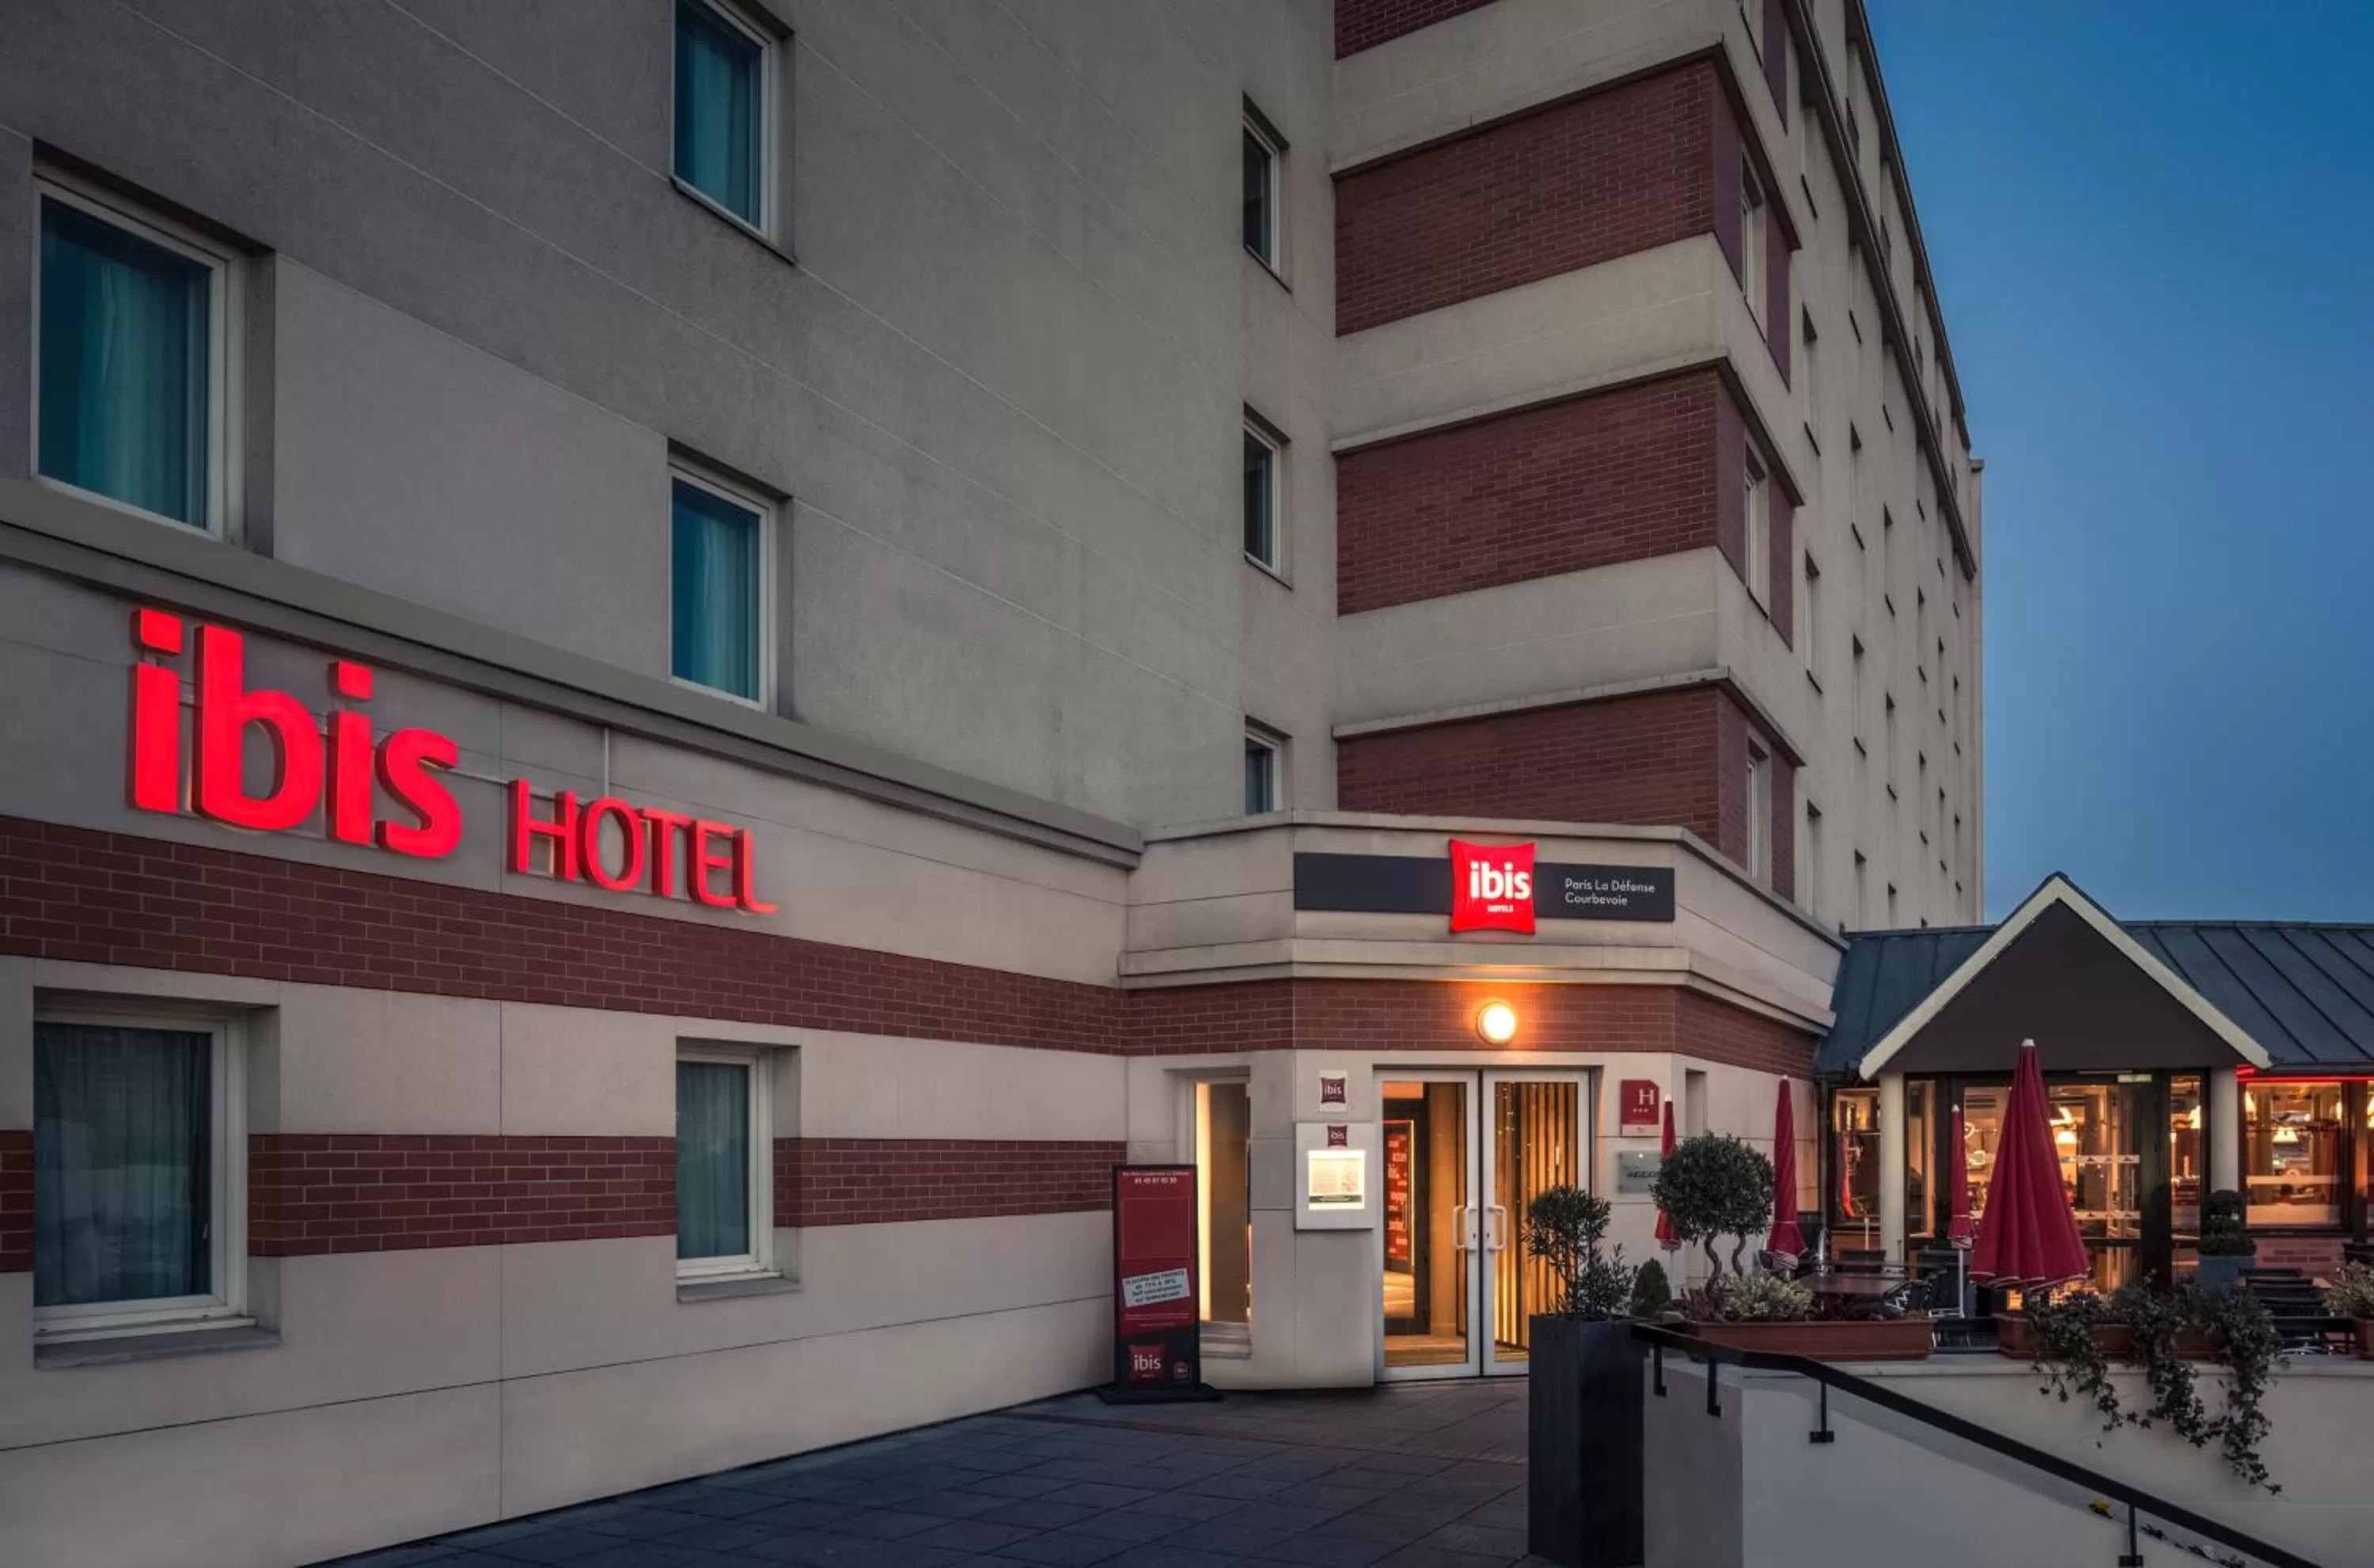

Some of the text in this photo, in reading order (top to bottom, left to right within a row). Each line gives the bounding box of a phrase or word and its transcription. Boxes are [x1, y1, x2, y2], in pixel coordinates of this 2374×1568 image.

[127, 607, 777, 915] ibis HOTEL
[1470, 861, 1530, 900] ibis
[1564, 877, 1655, 892] Paris La Défense
[1564, 892, 1628, 905] Courbevoie
[1324, 1084, 1342, 1096] ibis
[1639, 1089, 1655, 1105] H
[1134, 1354, 1162, 1371] ibis
